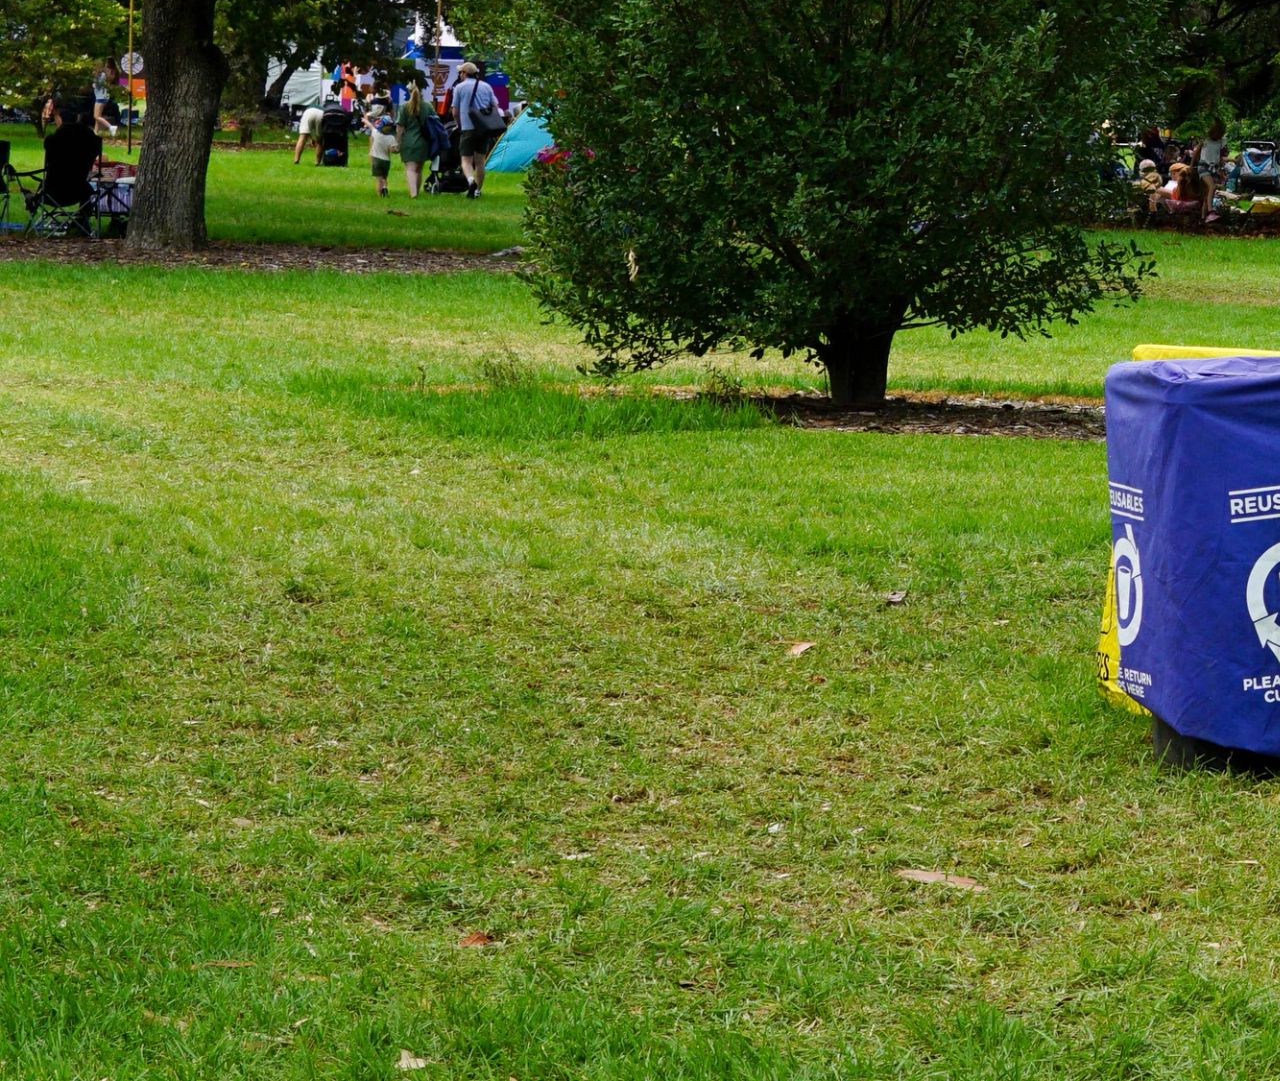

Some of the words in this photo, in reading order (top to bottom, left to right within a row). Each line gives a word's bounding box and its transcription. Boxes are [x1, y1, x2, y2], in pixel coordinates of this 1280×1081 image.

[1111, 490, 1144, 514] EUSABLES
[1124, 670, 1152, 687] RETURN
[1128, 680, 1145, 698] HERE
